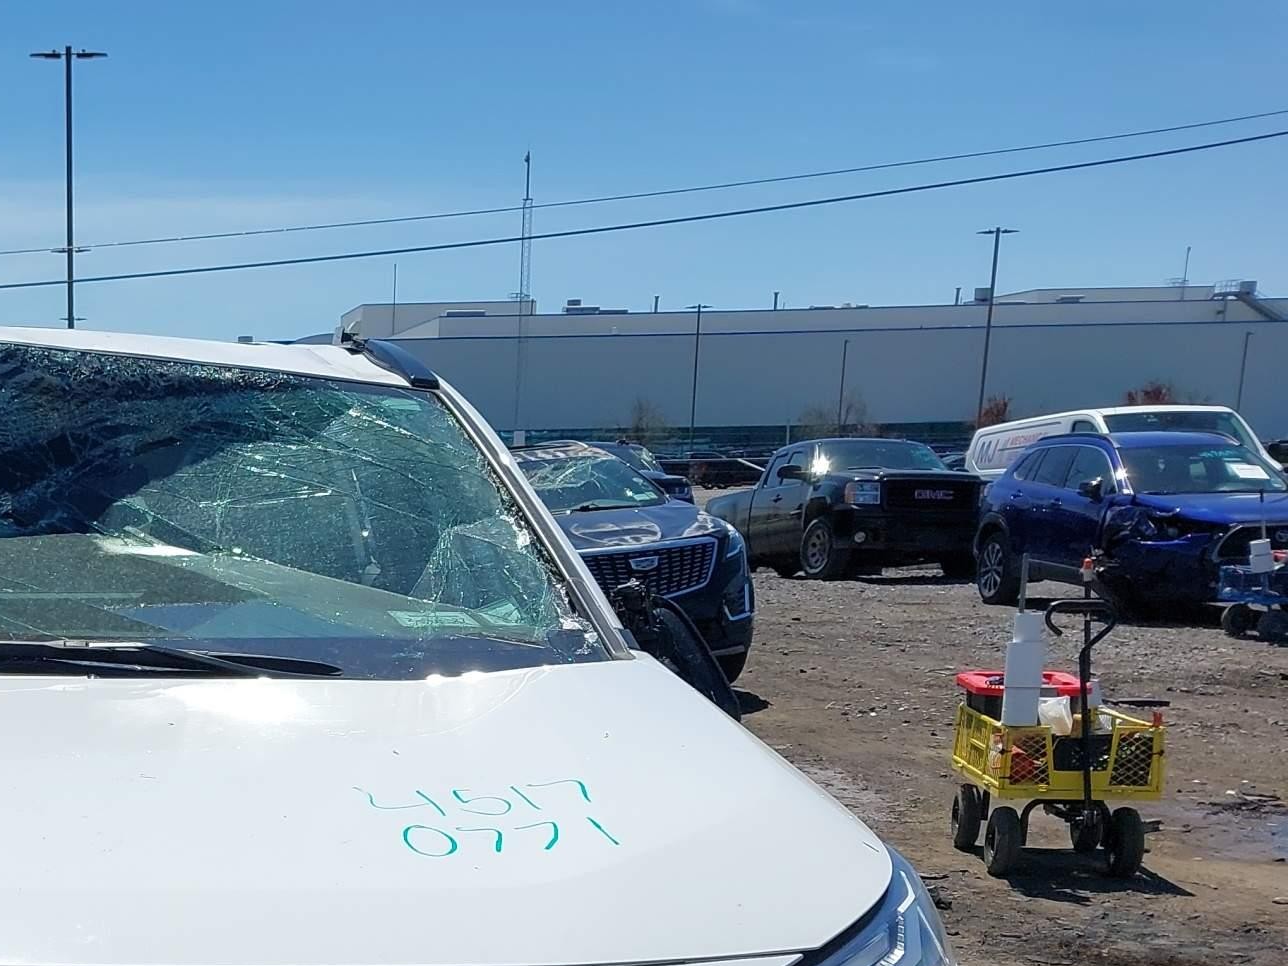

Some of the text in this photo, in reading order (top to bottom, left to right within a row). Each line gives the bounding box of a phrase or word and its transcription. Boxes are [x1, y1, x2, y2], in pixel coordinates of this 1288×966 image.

[915, 489, 954, 500] GMC
[352, 779, 592, 817] 4517
[402, 815, 621, 857] 0771
